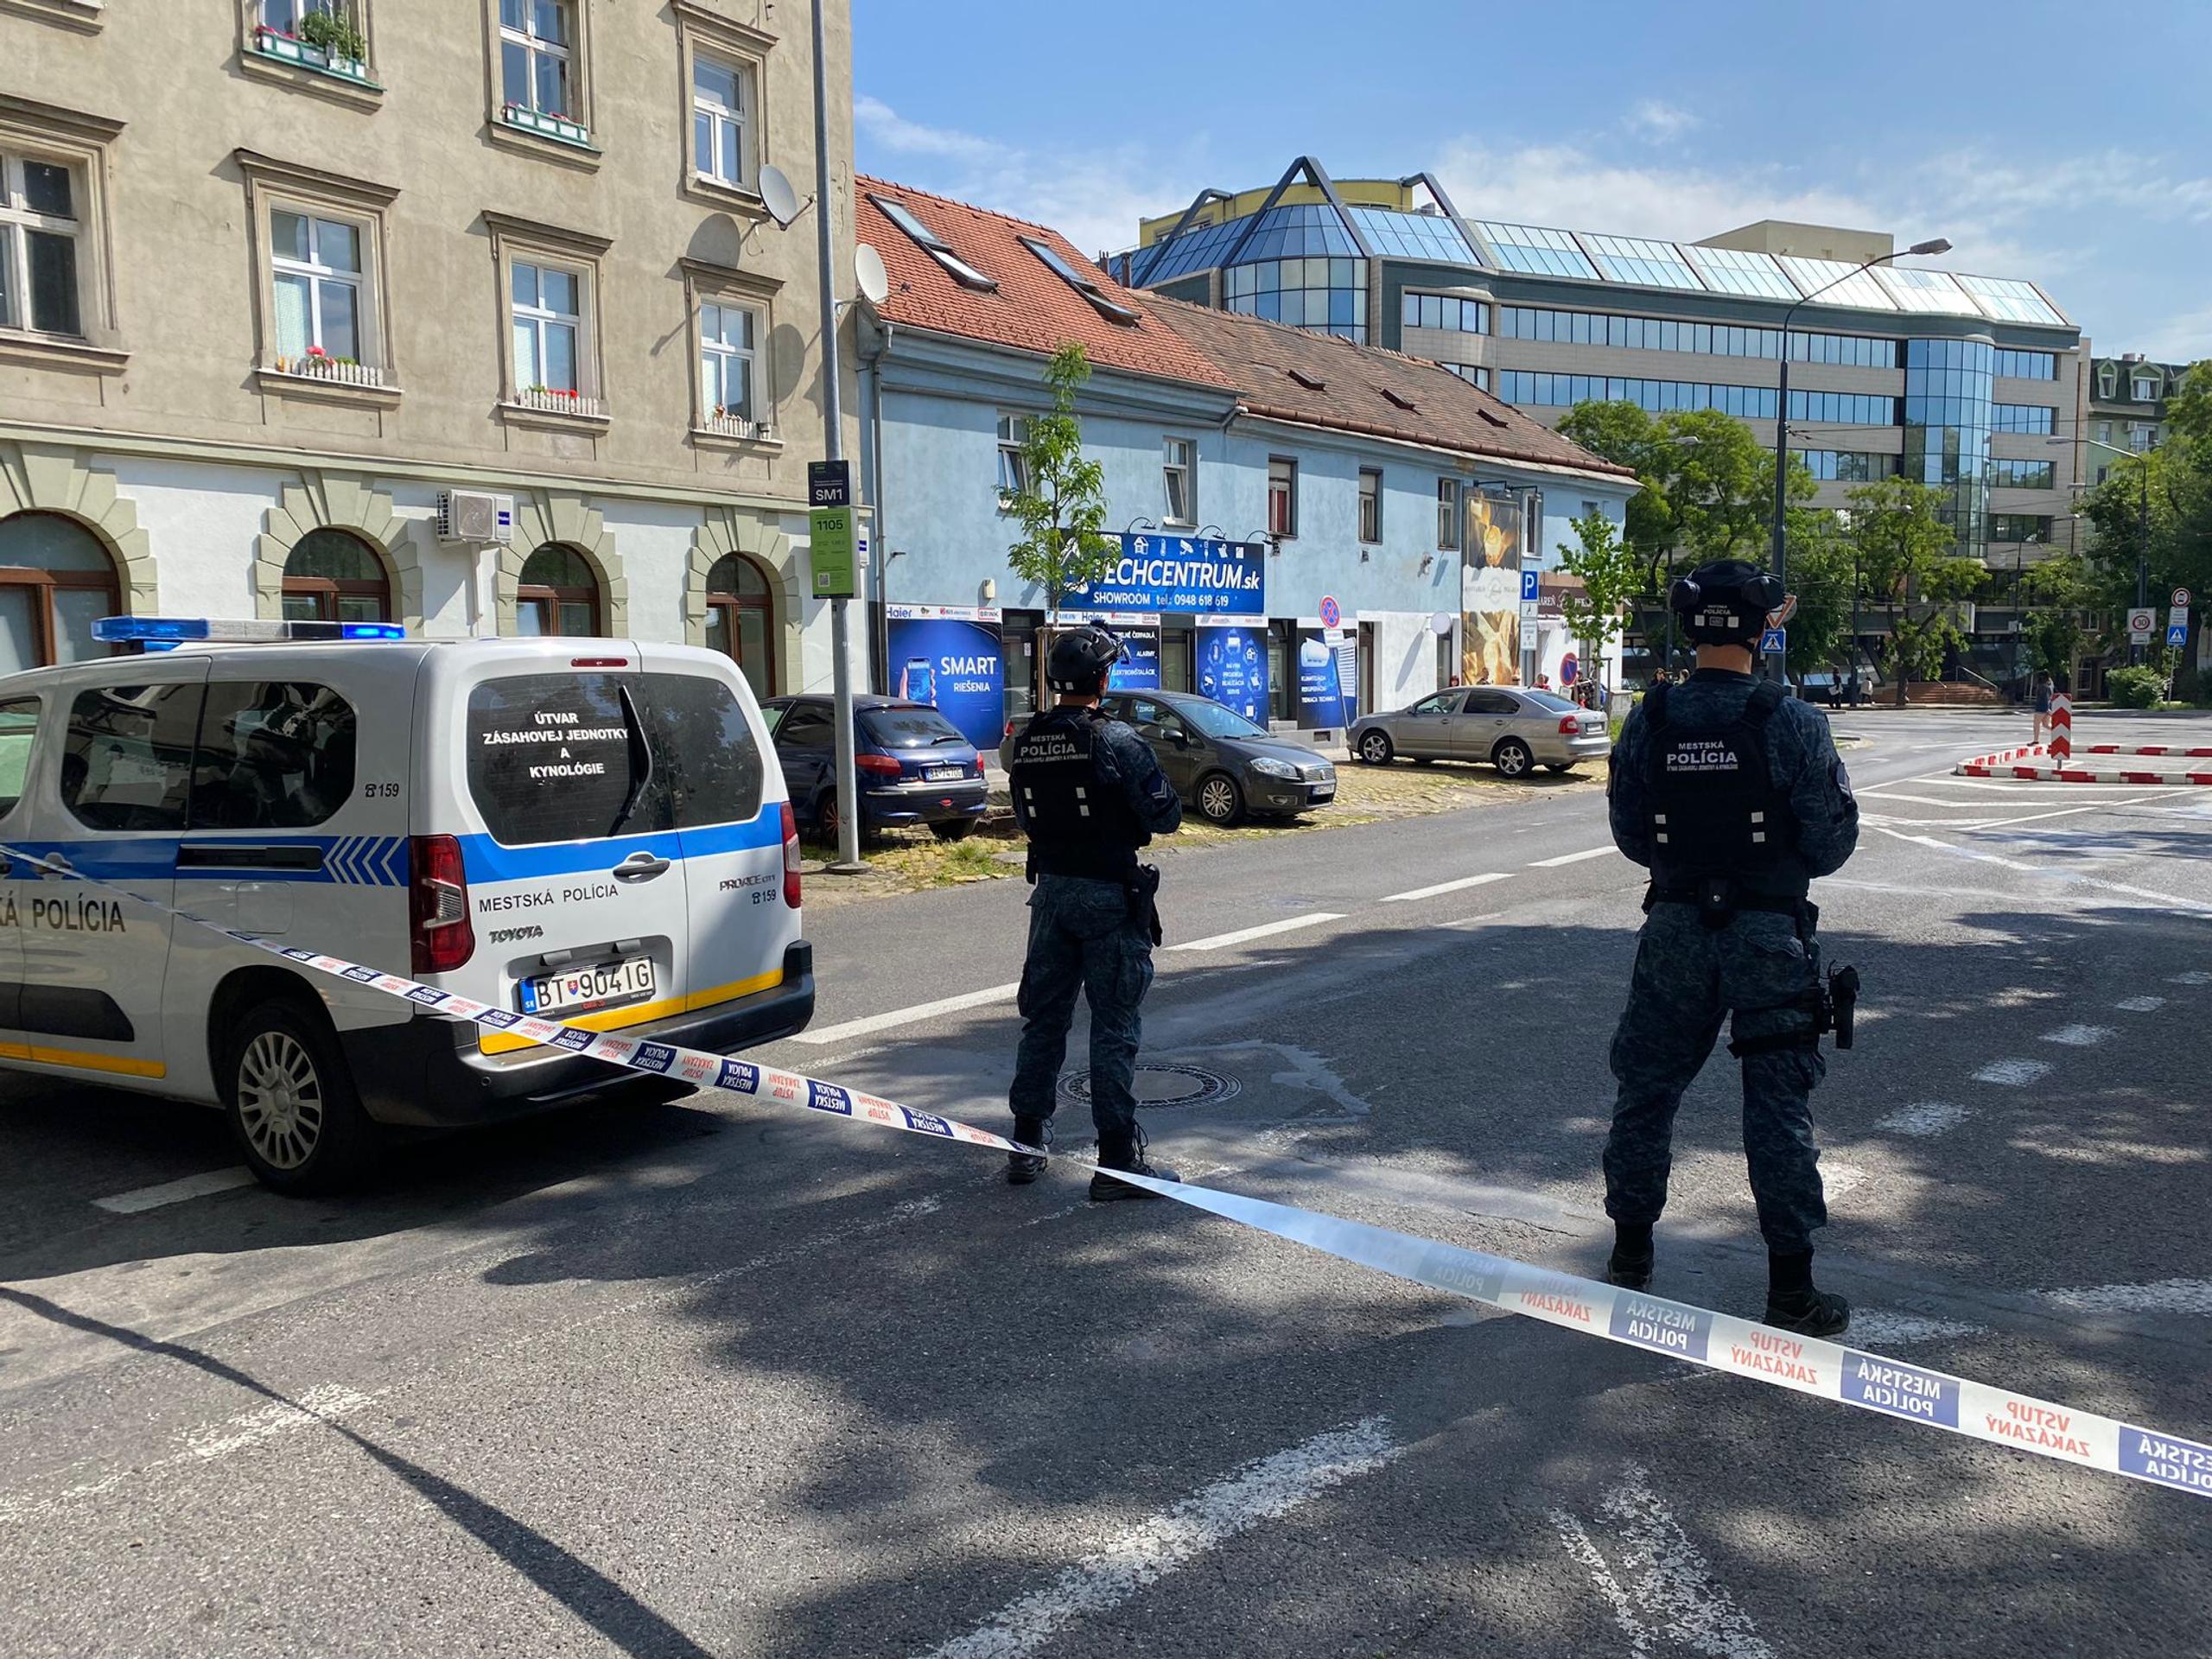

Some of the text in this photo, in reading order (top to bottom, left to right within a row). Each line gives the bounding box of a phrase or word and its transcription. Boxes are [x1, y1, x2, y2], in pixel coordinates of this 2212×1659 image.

[815, 488, 842, 500] SM1
[817, 519, 843, 531] 1105
[1094, 558, 1259, 589] ECHCENTRUM.sk
[1524, 574, 1535, 597] P
[1093, 591, 1150, 605] SHOWROOM
[1174, 595, 1196, 606] 0948
[1198, 597, 1212, 606] 618
[1215, 597, 1229, 607] 619
[941, 657, 997, 675] SMART
[953, 680, 990, 692] RIEŠENIA
[534, 711, 579, 724] ÚTVAR
[483, 728, 629, 745] ZÁSAHOVEJ JEDNOTKY
[1030, 733, 1066, 742] MESTSKÁ
[560, 747, 570, 759] A
[1020, 741, 1076, 757] POLÍCIA
[1678, 741, 1725, 750] MESTSKÁ
[1667, 750, 1738, 765] POLÍCIA
[529, 761, 605, 778] KYNOLÓGIE
[378, 783, 399, 797] 159
[479, 883, 619, 912] MESTSKÁ POLÍCIA
[762, 889, 776, 902] 159
[32, 893, 126, 932] POLÍCIA
[489, 925, 543, 944] TOYOTA
[537, 978, 564, 1007] BT
[525, 1000, 535, 1008] SK
[644, 1046, 670, 1059] POLÍCIA
[634, 1055, 667, 1070] MESTSKÁ
[728, 1063, 753, 1078] POLÍCIA
[721, 1075, 753, 1090] MESTSKÁ
[814, 1082, 842, 1097] POLÍCIA
[772, 1086, 795, 1100] VSTUP
[815, 1094, 845, 1111] MESTSKÁ
[868, 1107, 891, 1121] VSTUP
[912, 1118, 946, 1134] MESTSKÁ
